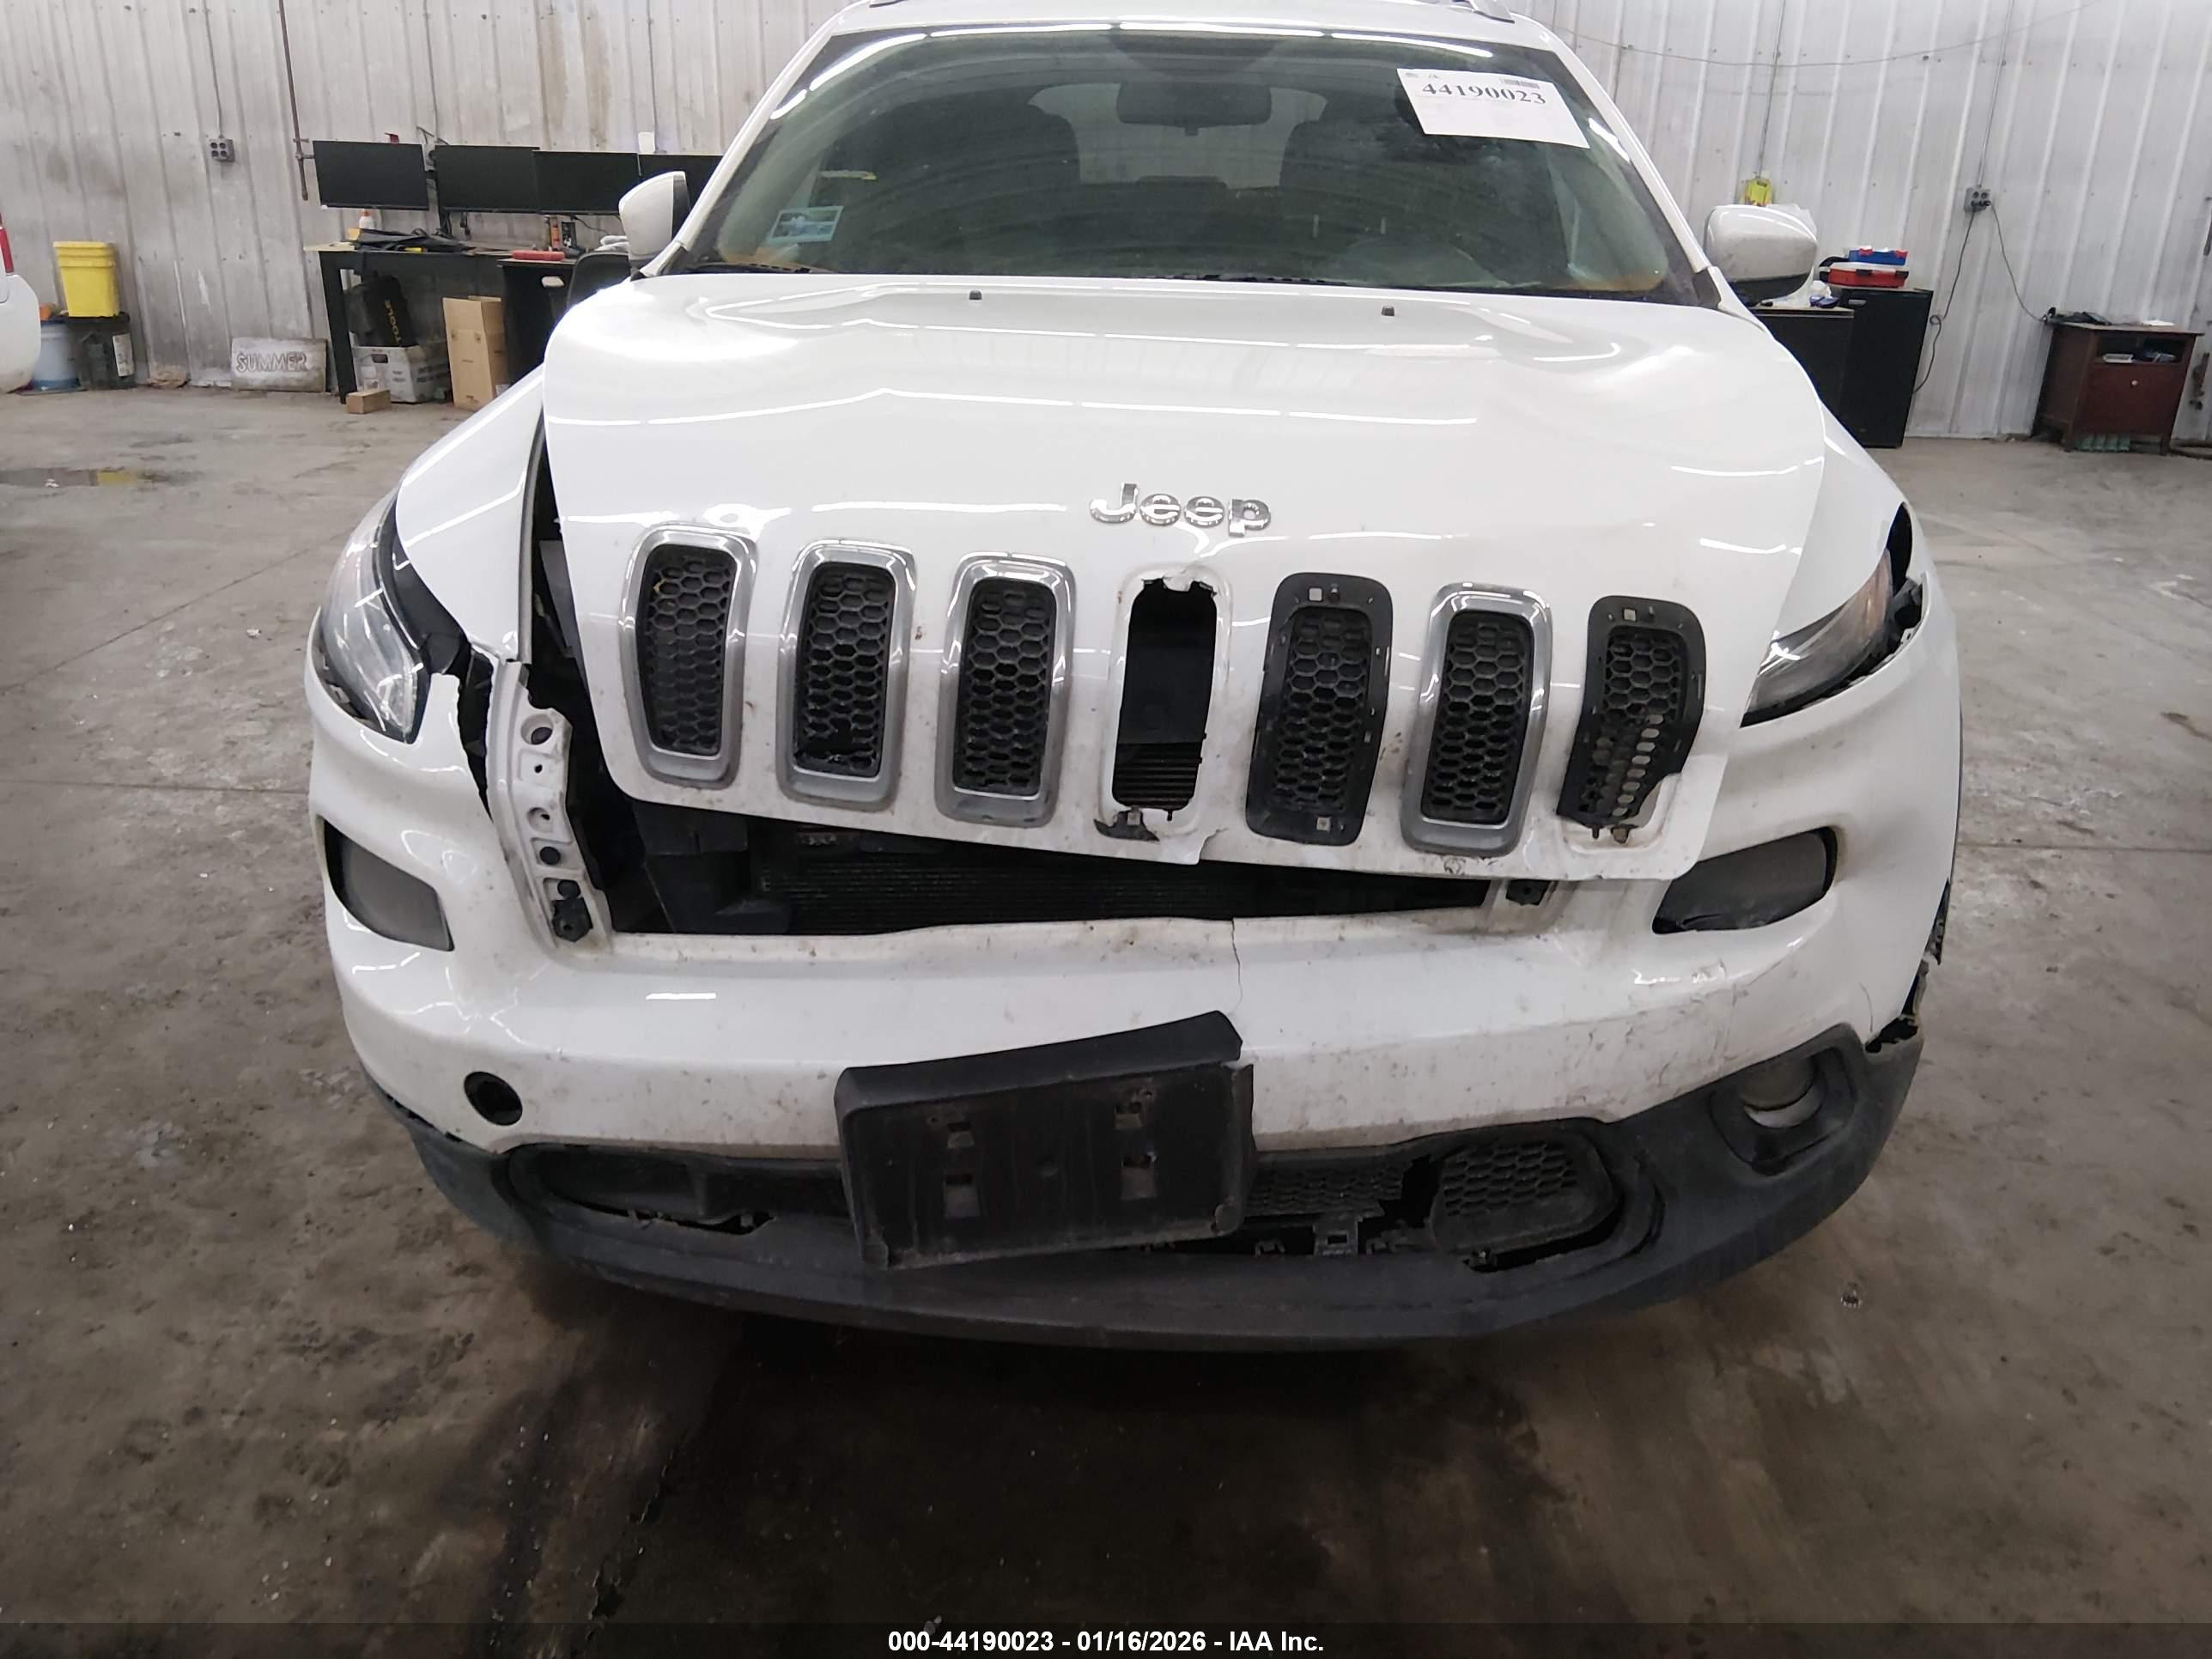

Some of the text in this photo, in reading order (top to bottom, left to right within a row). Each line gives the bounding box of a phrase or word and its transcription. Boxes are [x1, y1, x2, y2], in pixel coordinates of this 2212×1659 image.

[1421, 83, 1547, 105] 44190023
[235, 352, 307, 373] SUMMER
[1089, 483, 1272, 538] Jeep
